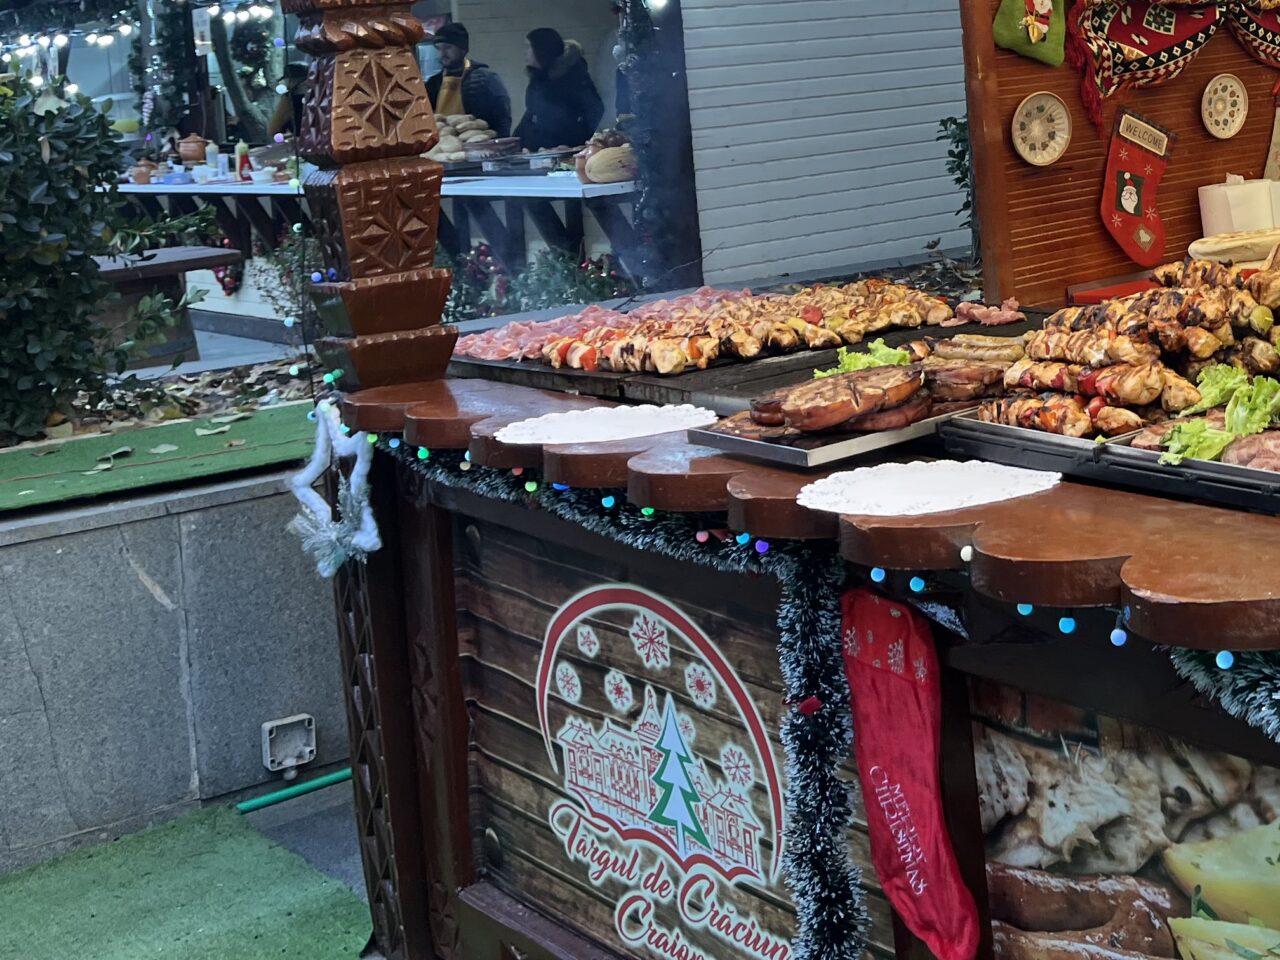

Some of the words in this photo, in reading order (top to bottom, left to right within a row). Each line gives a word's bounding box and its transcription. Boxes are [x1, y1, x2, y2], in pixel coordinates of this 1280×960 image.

[1125, 123, 1163, 149] WELCOME
[551, 803, 639, 882] Târgul
[643, 860, 673, 899] de
[680, 873, 790, 960] Crăciun
[617, 894, 704, 960] Craio
